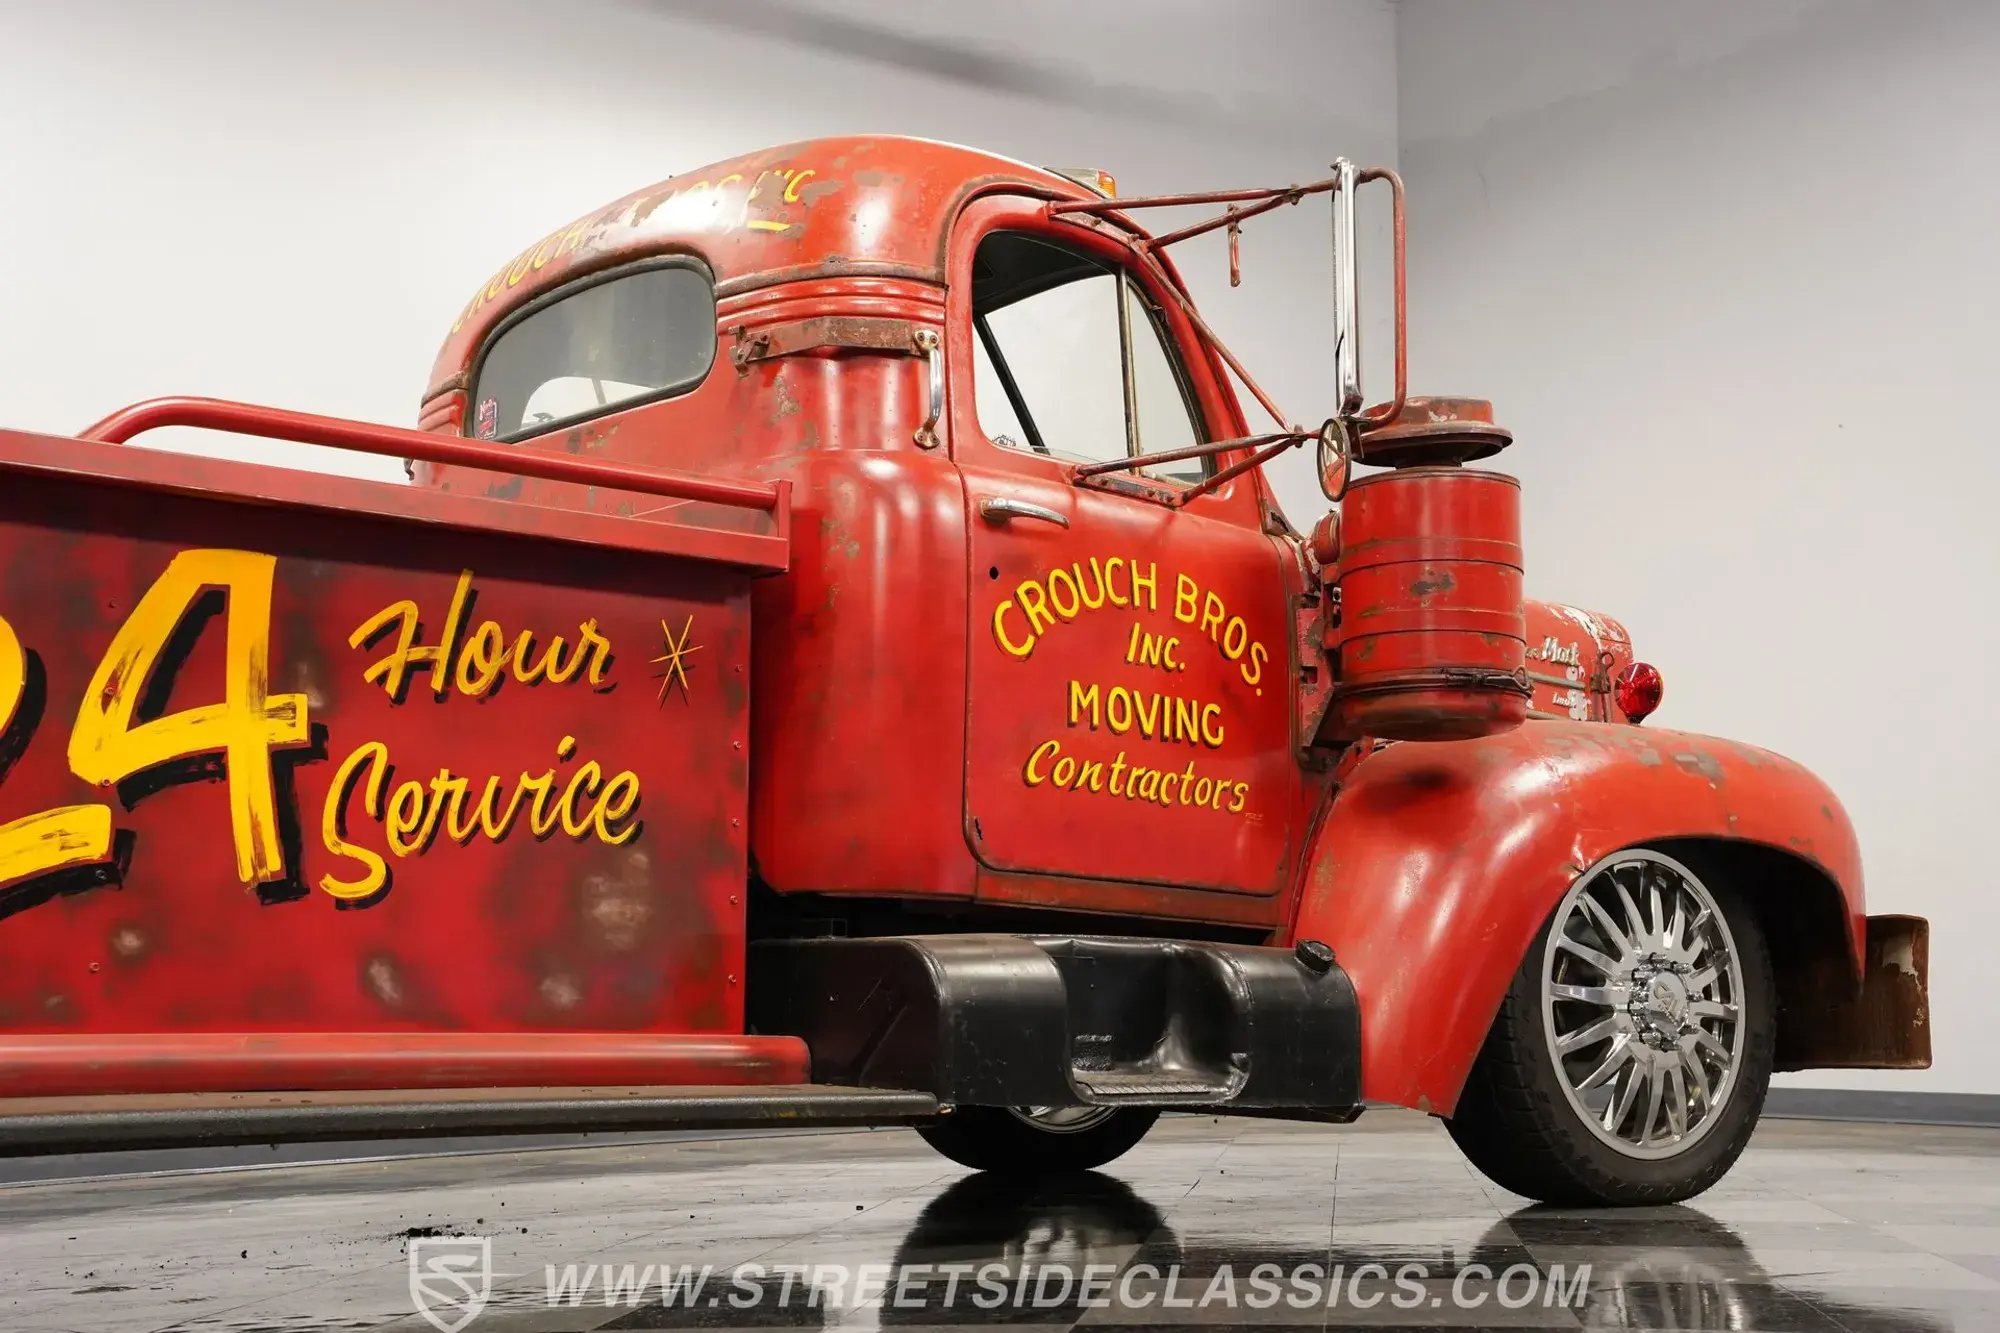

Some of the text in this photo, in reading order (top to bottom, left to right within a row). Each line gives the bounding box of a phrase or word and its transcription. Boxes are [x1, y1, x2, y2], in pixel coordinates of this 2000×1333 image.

[348, 569, 612, 698] Hour
[993, 556, 1268, 697] CROUCH BROS.
[1126, 621, 1186, 671] INC.
[1070, 680, 1224, 747] MOVING
[319, 735, 641, 900] Service
[1025, 739, 1249, 813] Contractors
